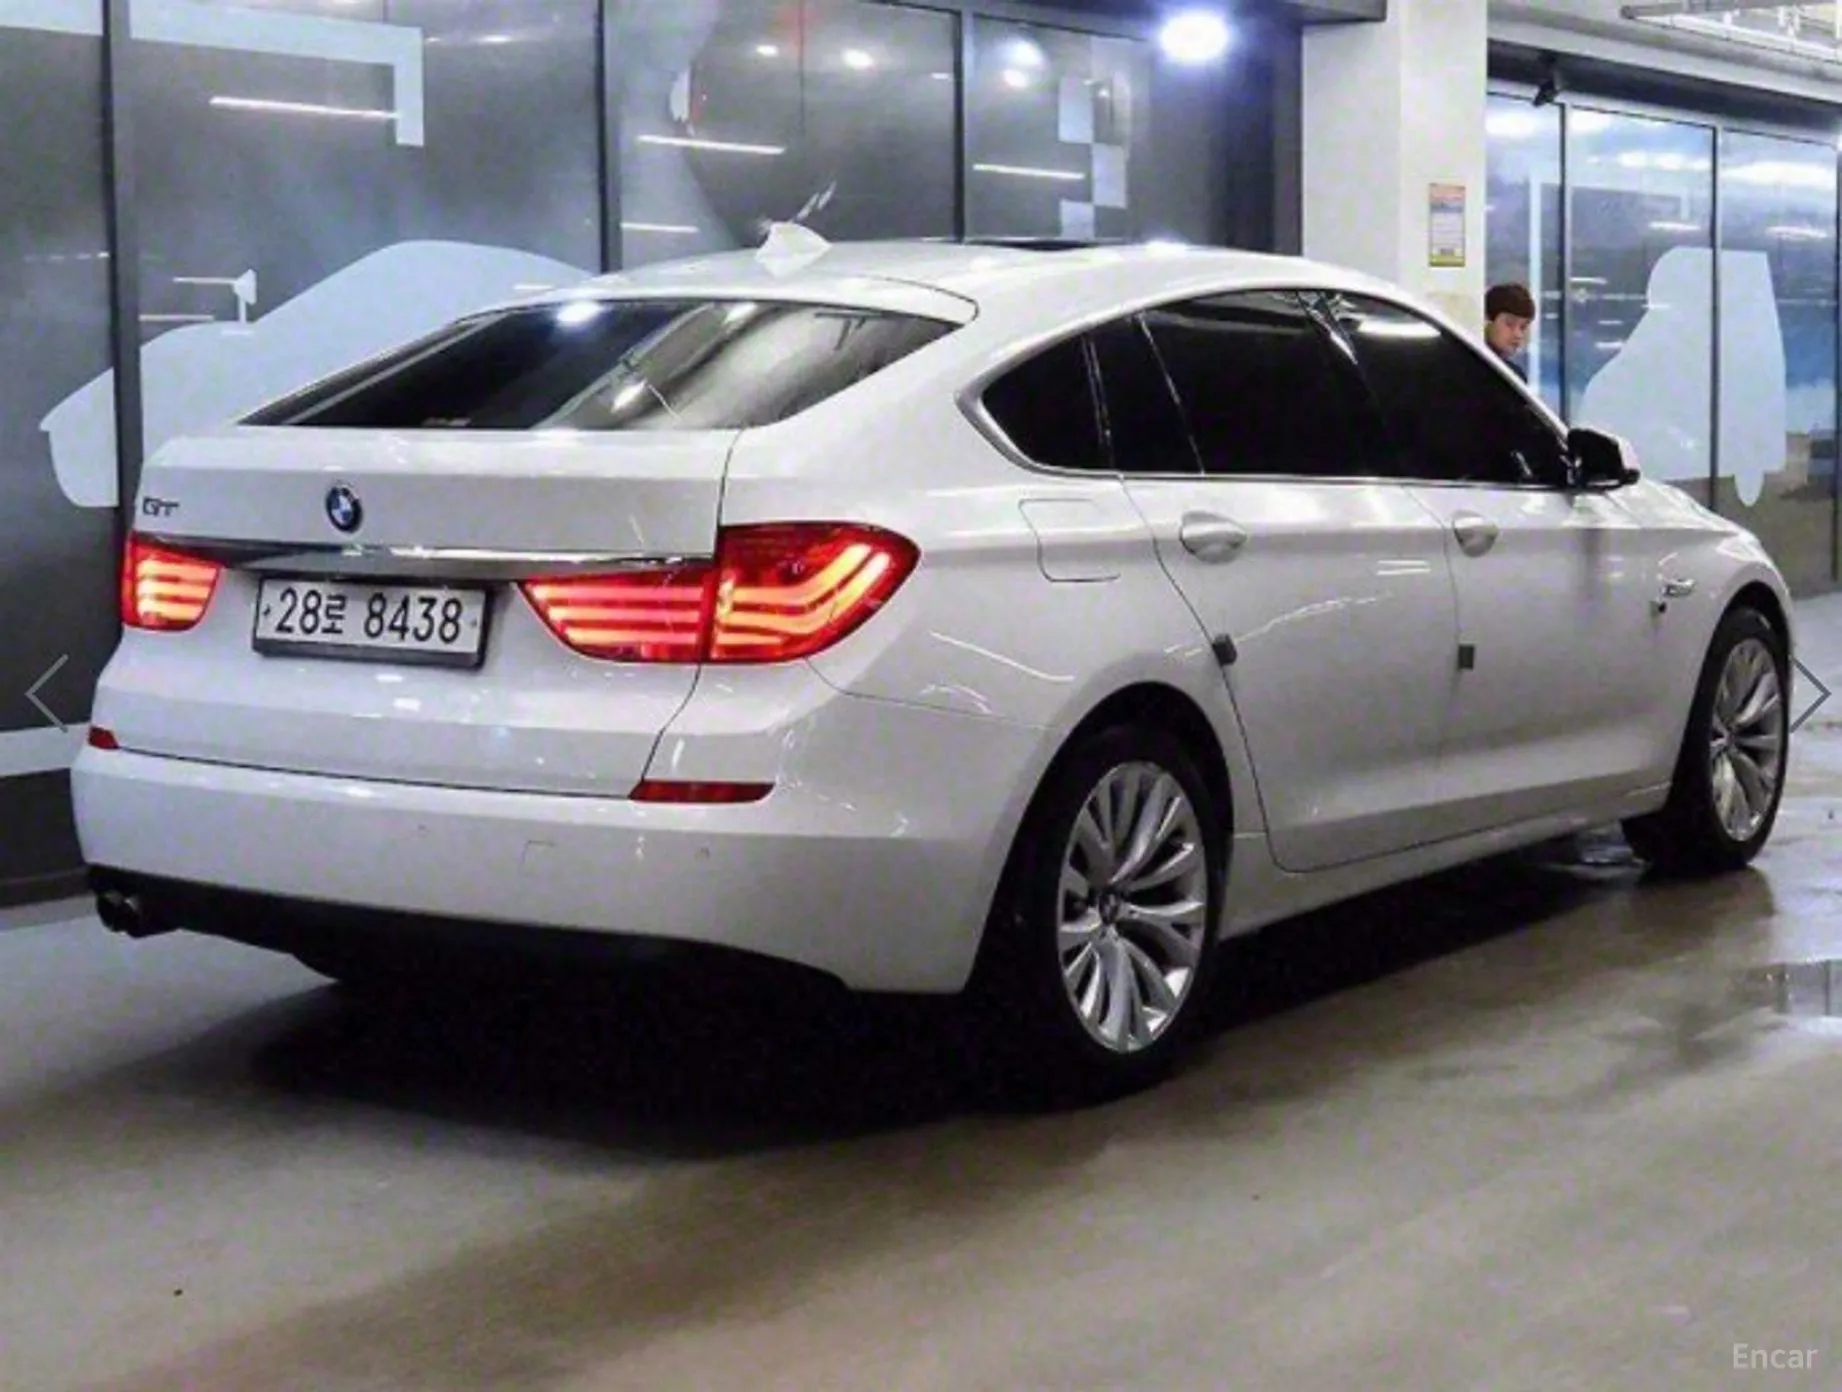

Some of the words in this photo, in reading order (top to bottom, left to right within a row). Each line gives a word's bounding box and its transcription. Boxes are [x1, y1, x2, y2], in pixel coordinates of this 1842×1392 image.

[142, 497, 180, 516] GT
[275, 586, 348, 635] 28로
[364, 592, 464, 644] 8438
